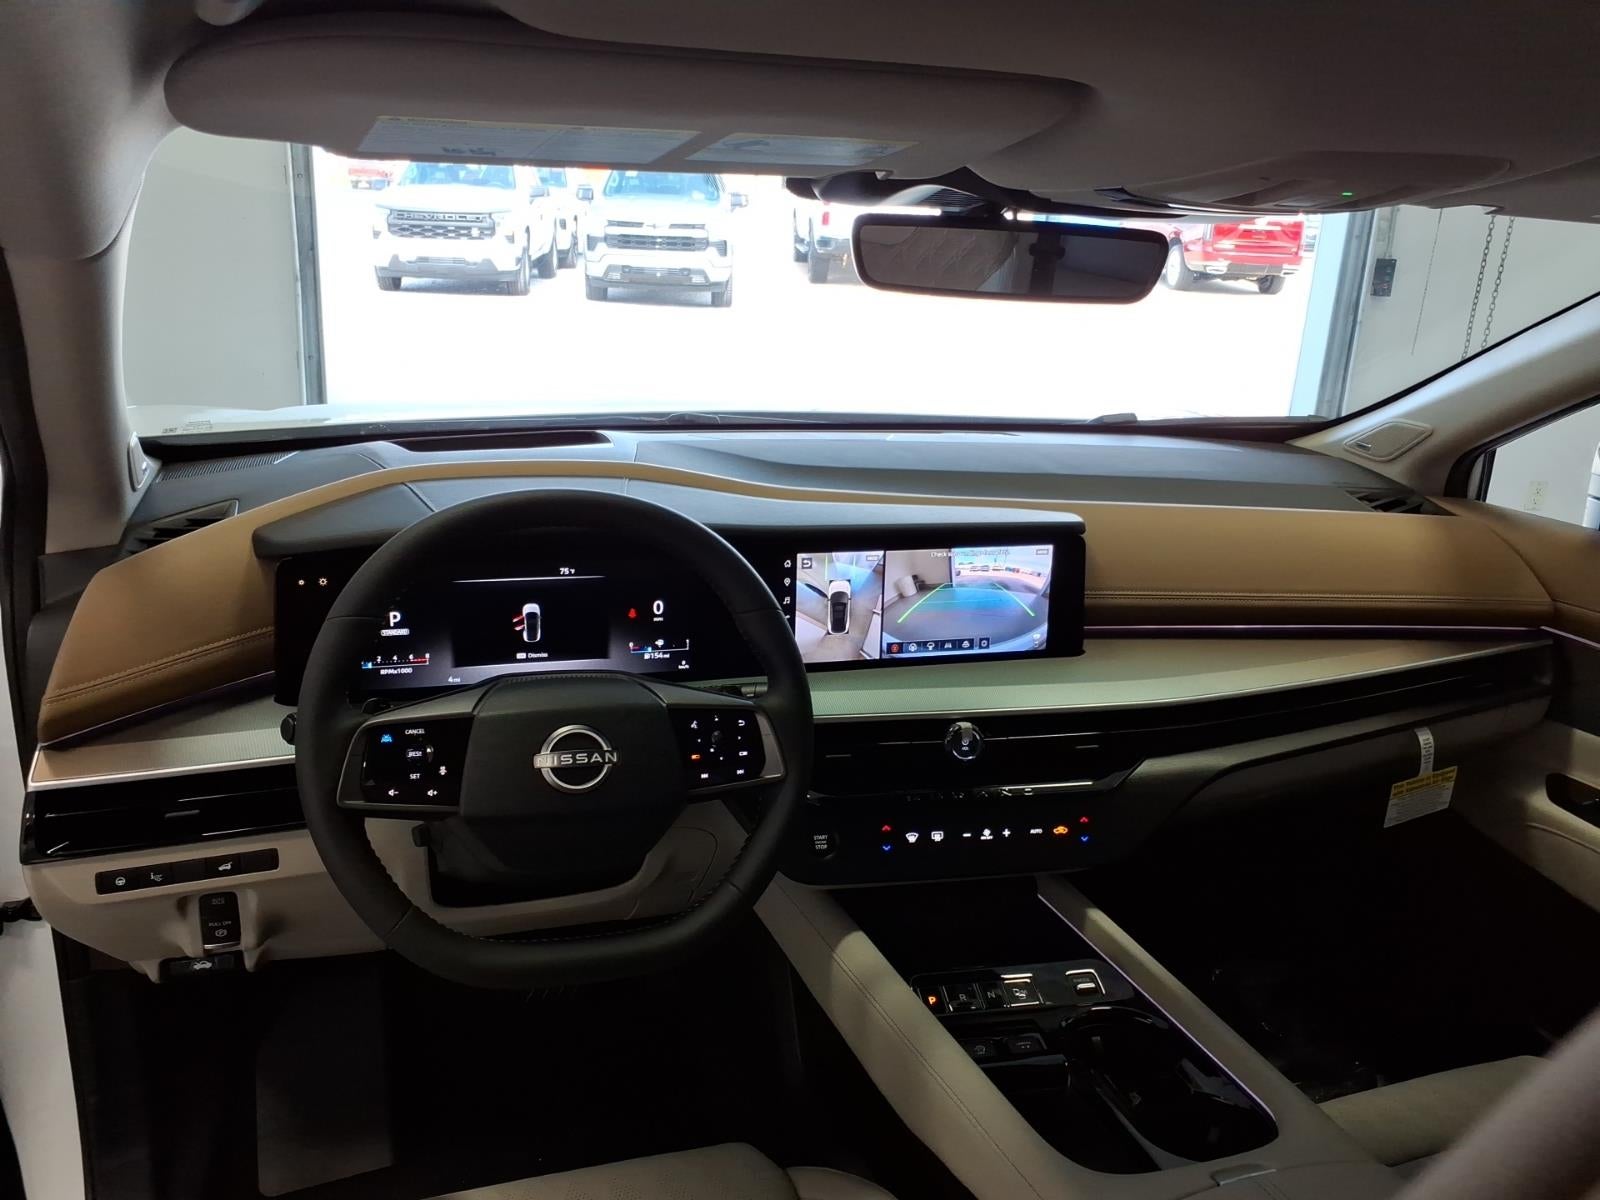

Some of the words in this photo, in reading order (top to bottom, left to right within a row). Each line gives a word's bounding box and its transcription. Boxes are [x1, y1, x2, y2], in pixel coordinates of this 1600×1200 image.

[653, 600, 664, 614] 0
[389, 611, 401, 627] P
[537, 752, 617, 767] NISSAN
[928, 996, 936, 1004] P
